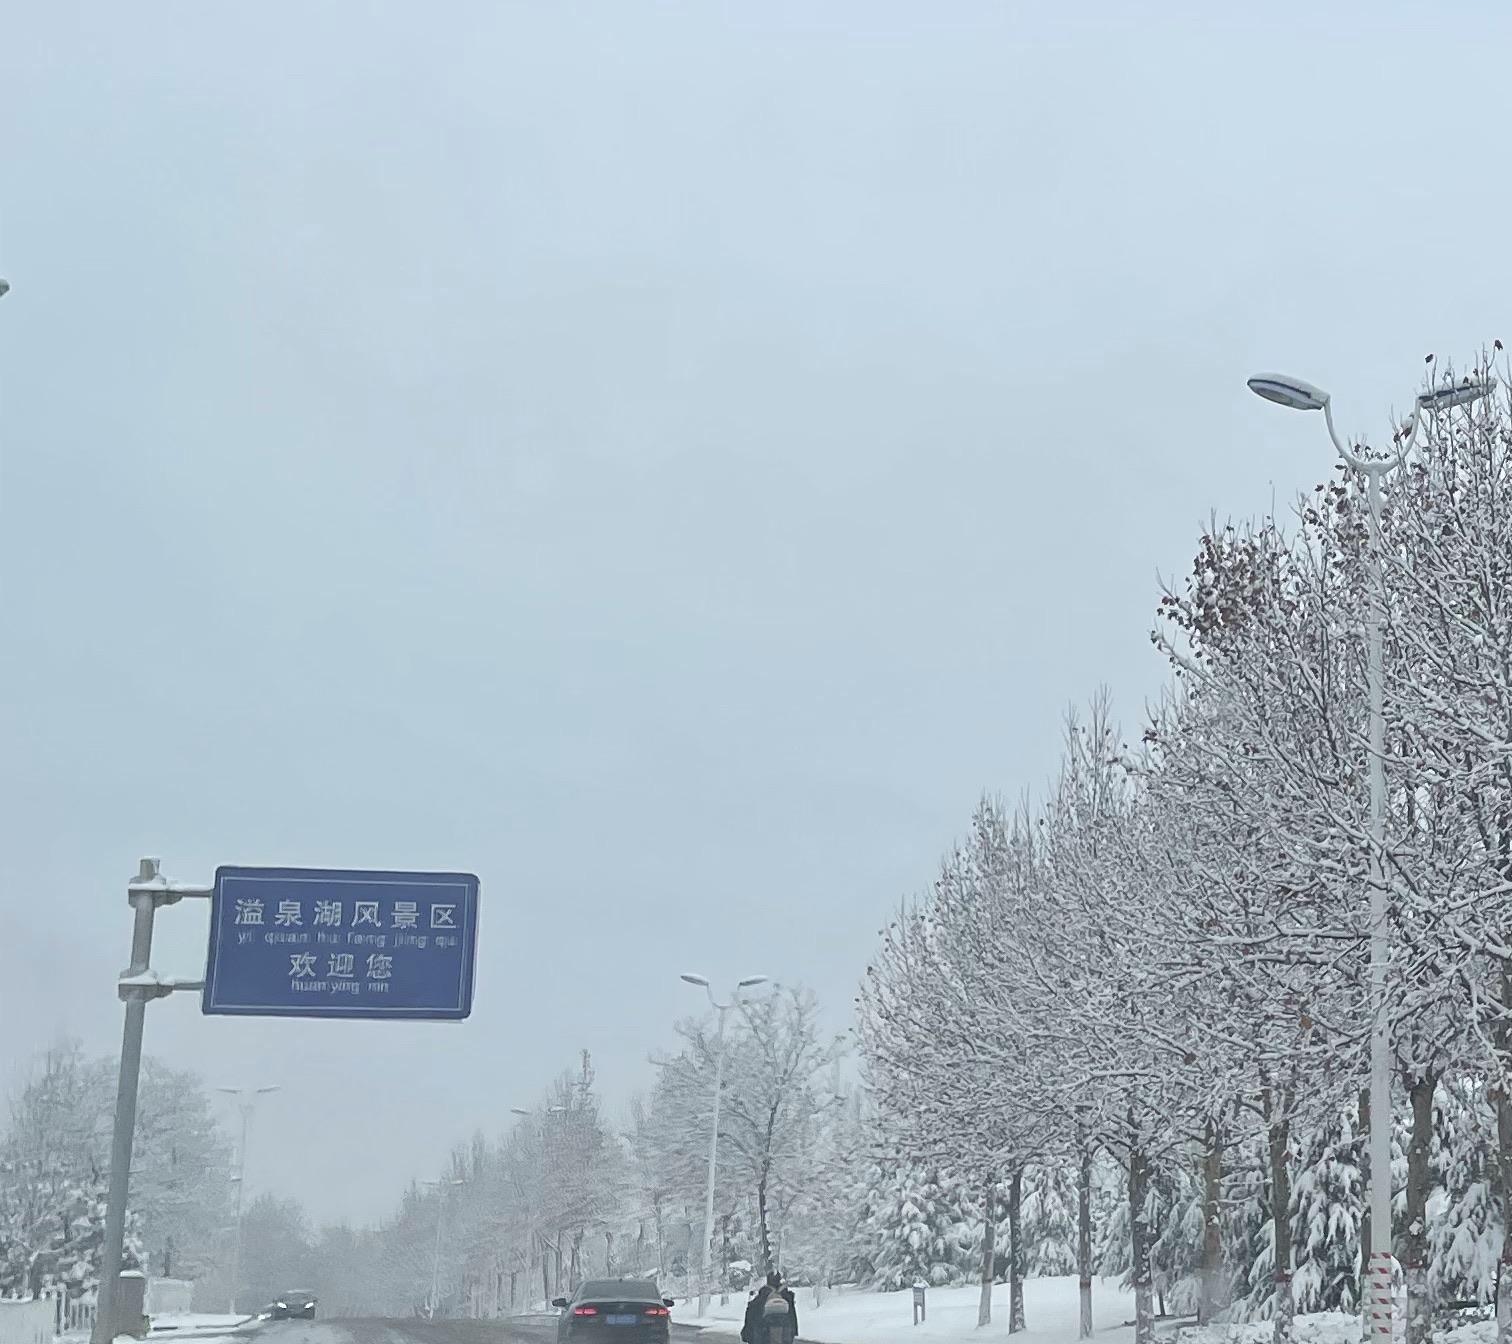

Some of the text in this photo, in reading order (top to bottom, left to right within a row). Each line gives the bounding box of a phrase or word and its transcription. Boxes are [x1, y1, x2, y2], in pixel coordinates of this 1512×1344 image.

[235, 899, 457, 929] 溢泉湖风景区
[289, 952, 393, 979] 欢迎您
